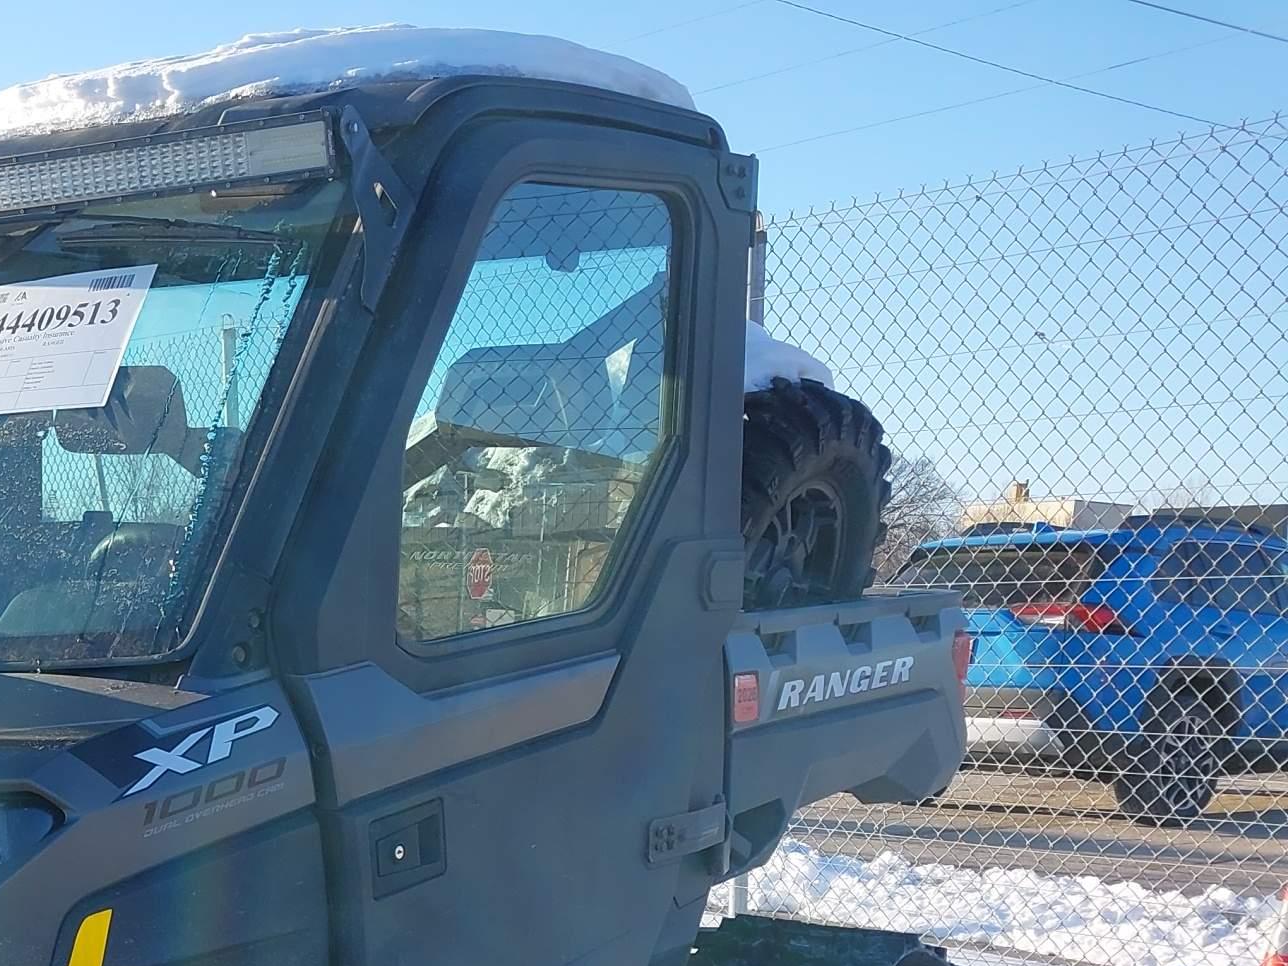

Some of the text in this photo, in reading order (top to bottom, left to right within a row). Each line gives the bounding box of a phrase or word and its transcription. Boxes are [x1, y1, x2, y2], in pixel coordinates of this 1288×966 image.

[777, 656, 914, 711] RANGER
[121, 705, 280, 798] XP
[143, 757, 287, 827] 1000
[143, 782, 286, 838] DUAL OVERHEAD CAM
